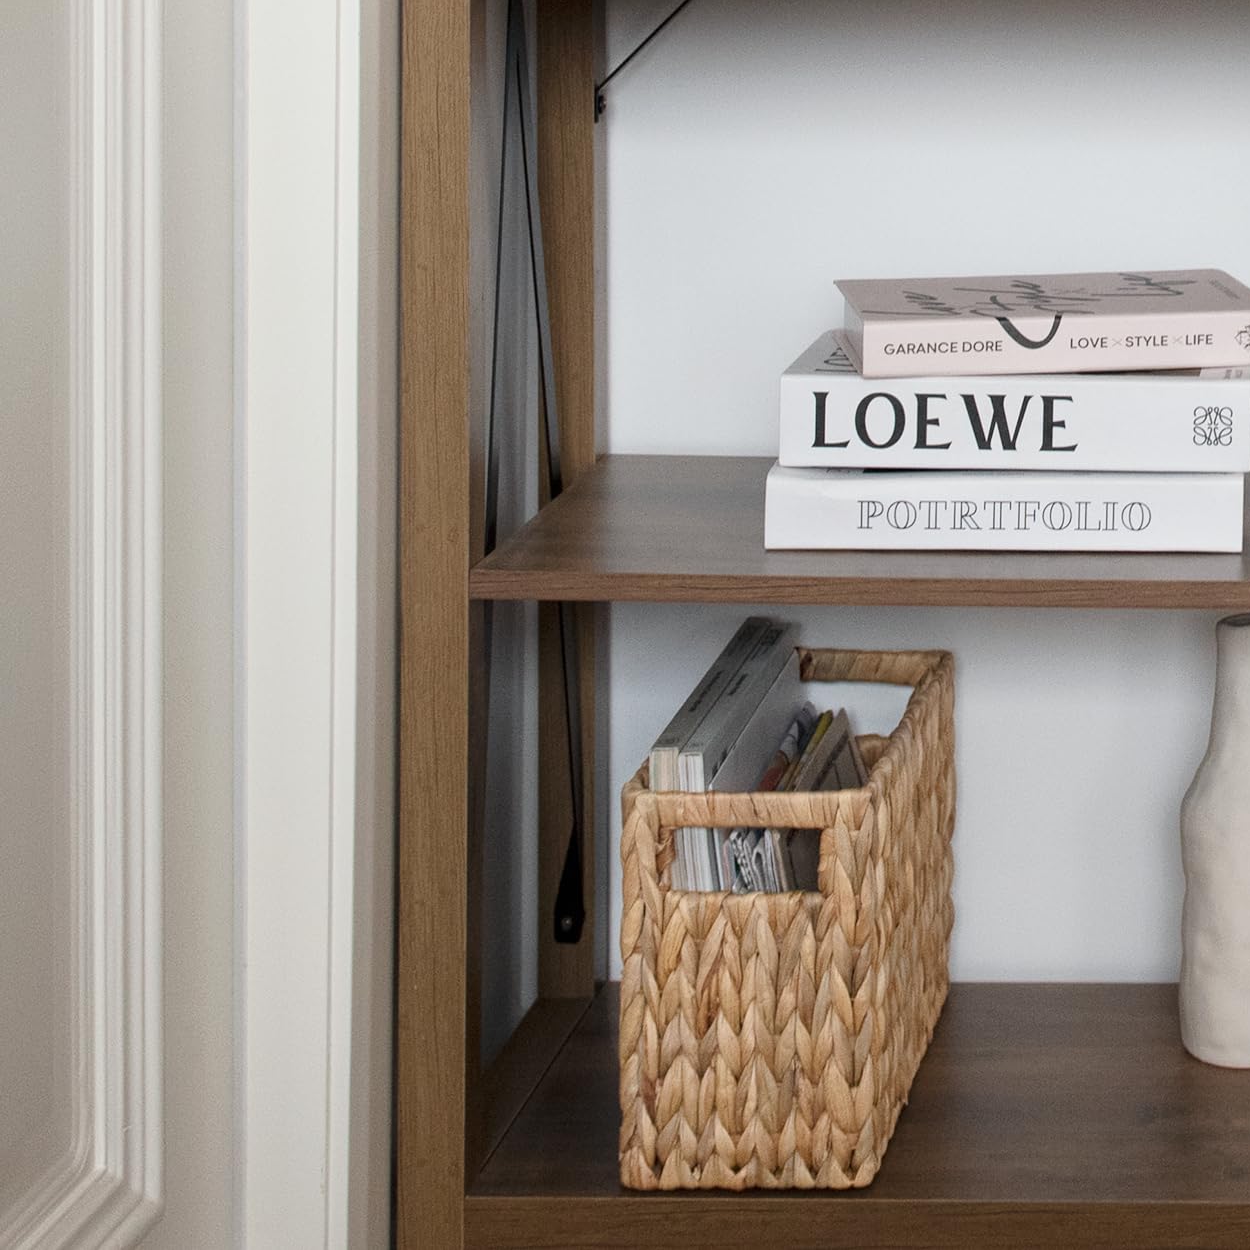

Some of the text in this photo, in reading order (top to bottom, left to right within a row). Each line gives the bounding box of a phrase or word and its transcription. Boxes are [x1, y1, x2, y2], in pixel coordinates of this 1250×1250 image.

[884, 341, 958, 355] GARANCE
[1070, 336, 1108, 350] LOVE
[1125, 335, 1169, 348] STYLE
[1185, 333, 1214, 346] LIFE
[811, 391, 1079, 452] LOEWE
[856, 499, 1153, 532] POTRTFOLIO
